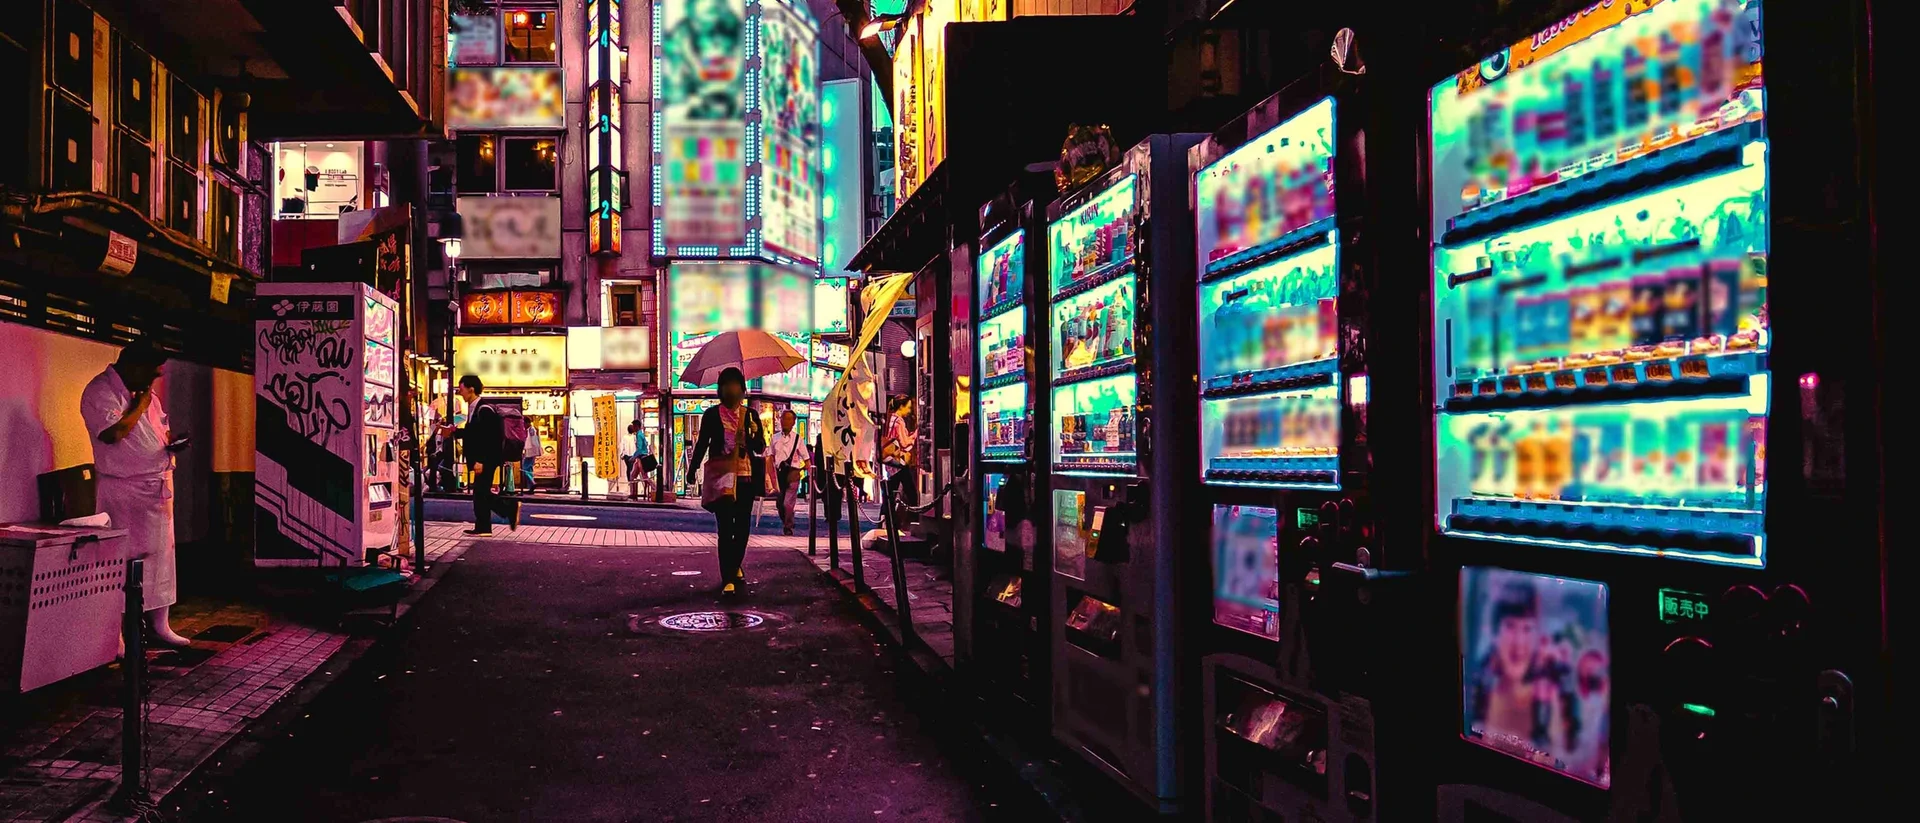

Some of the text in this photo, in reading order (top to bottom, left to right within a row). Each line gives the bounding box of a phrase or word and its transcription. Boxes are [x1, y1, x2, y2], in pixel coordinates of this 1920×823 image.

[601, 30, 609, 48] 4
[601, 115, 609, 133] 3
[601, 200, 609, 219] 2
[297, 301, 339, 313] 伊藤園
[1665, 597, 1709, 620] 販売中
